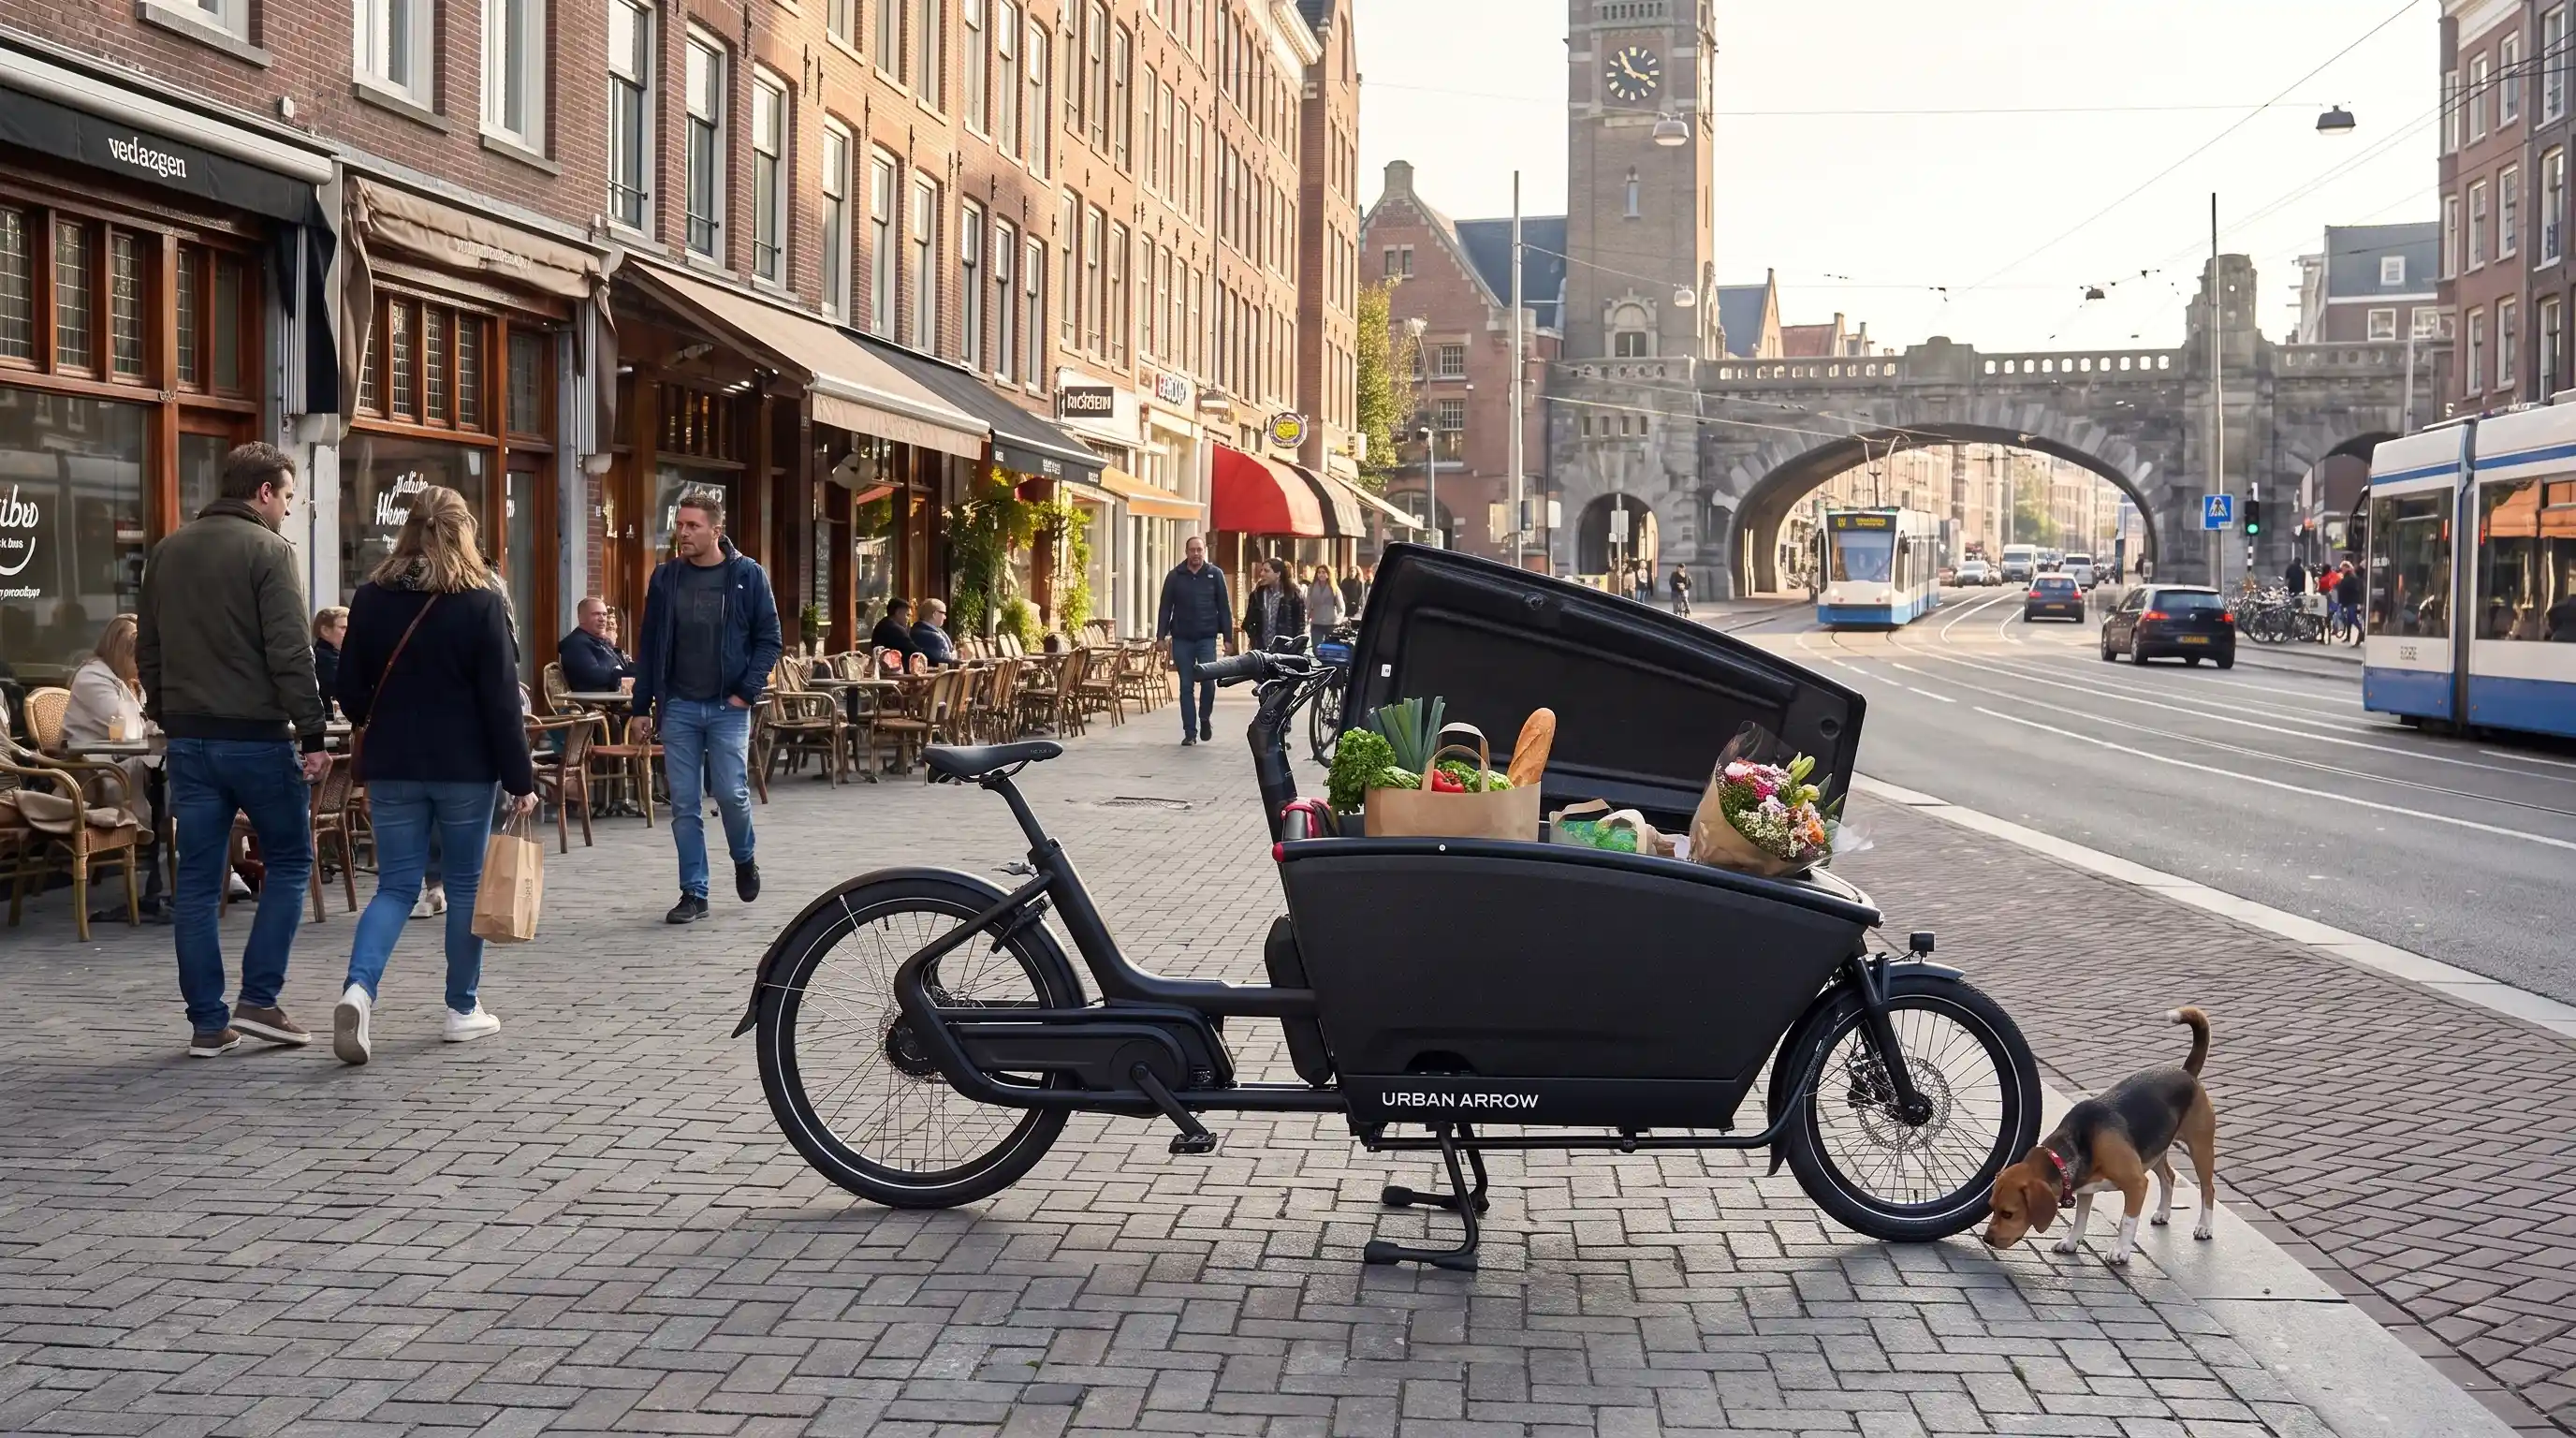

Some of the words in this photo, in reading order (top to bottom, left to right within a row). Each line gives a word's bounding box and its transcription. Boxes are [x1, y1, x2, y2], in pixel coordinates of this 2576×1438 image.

[108, 136, 187, 179] vedazgen
[1382, 1092, 1455, 1108] URBAN
[1459, 1093, 1539, 1108] ARROW
